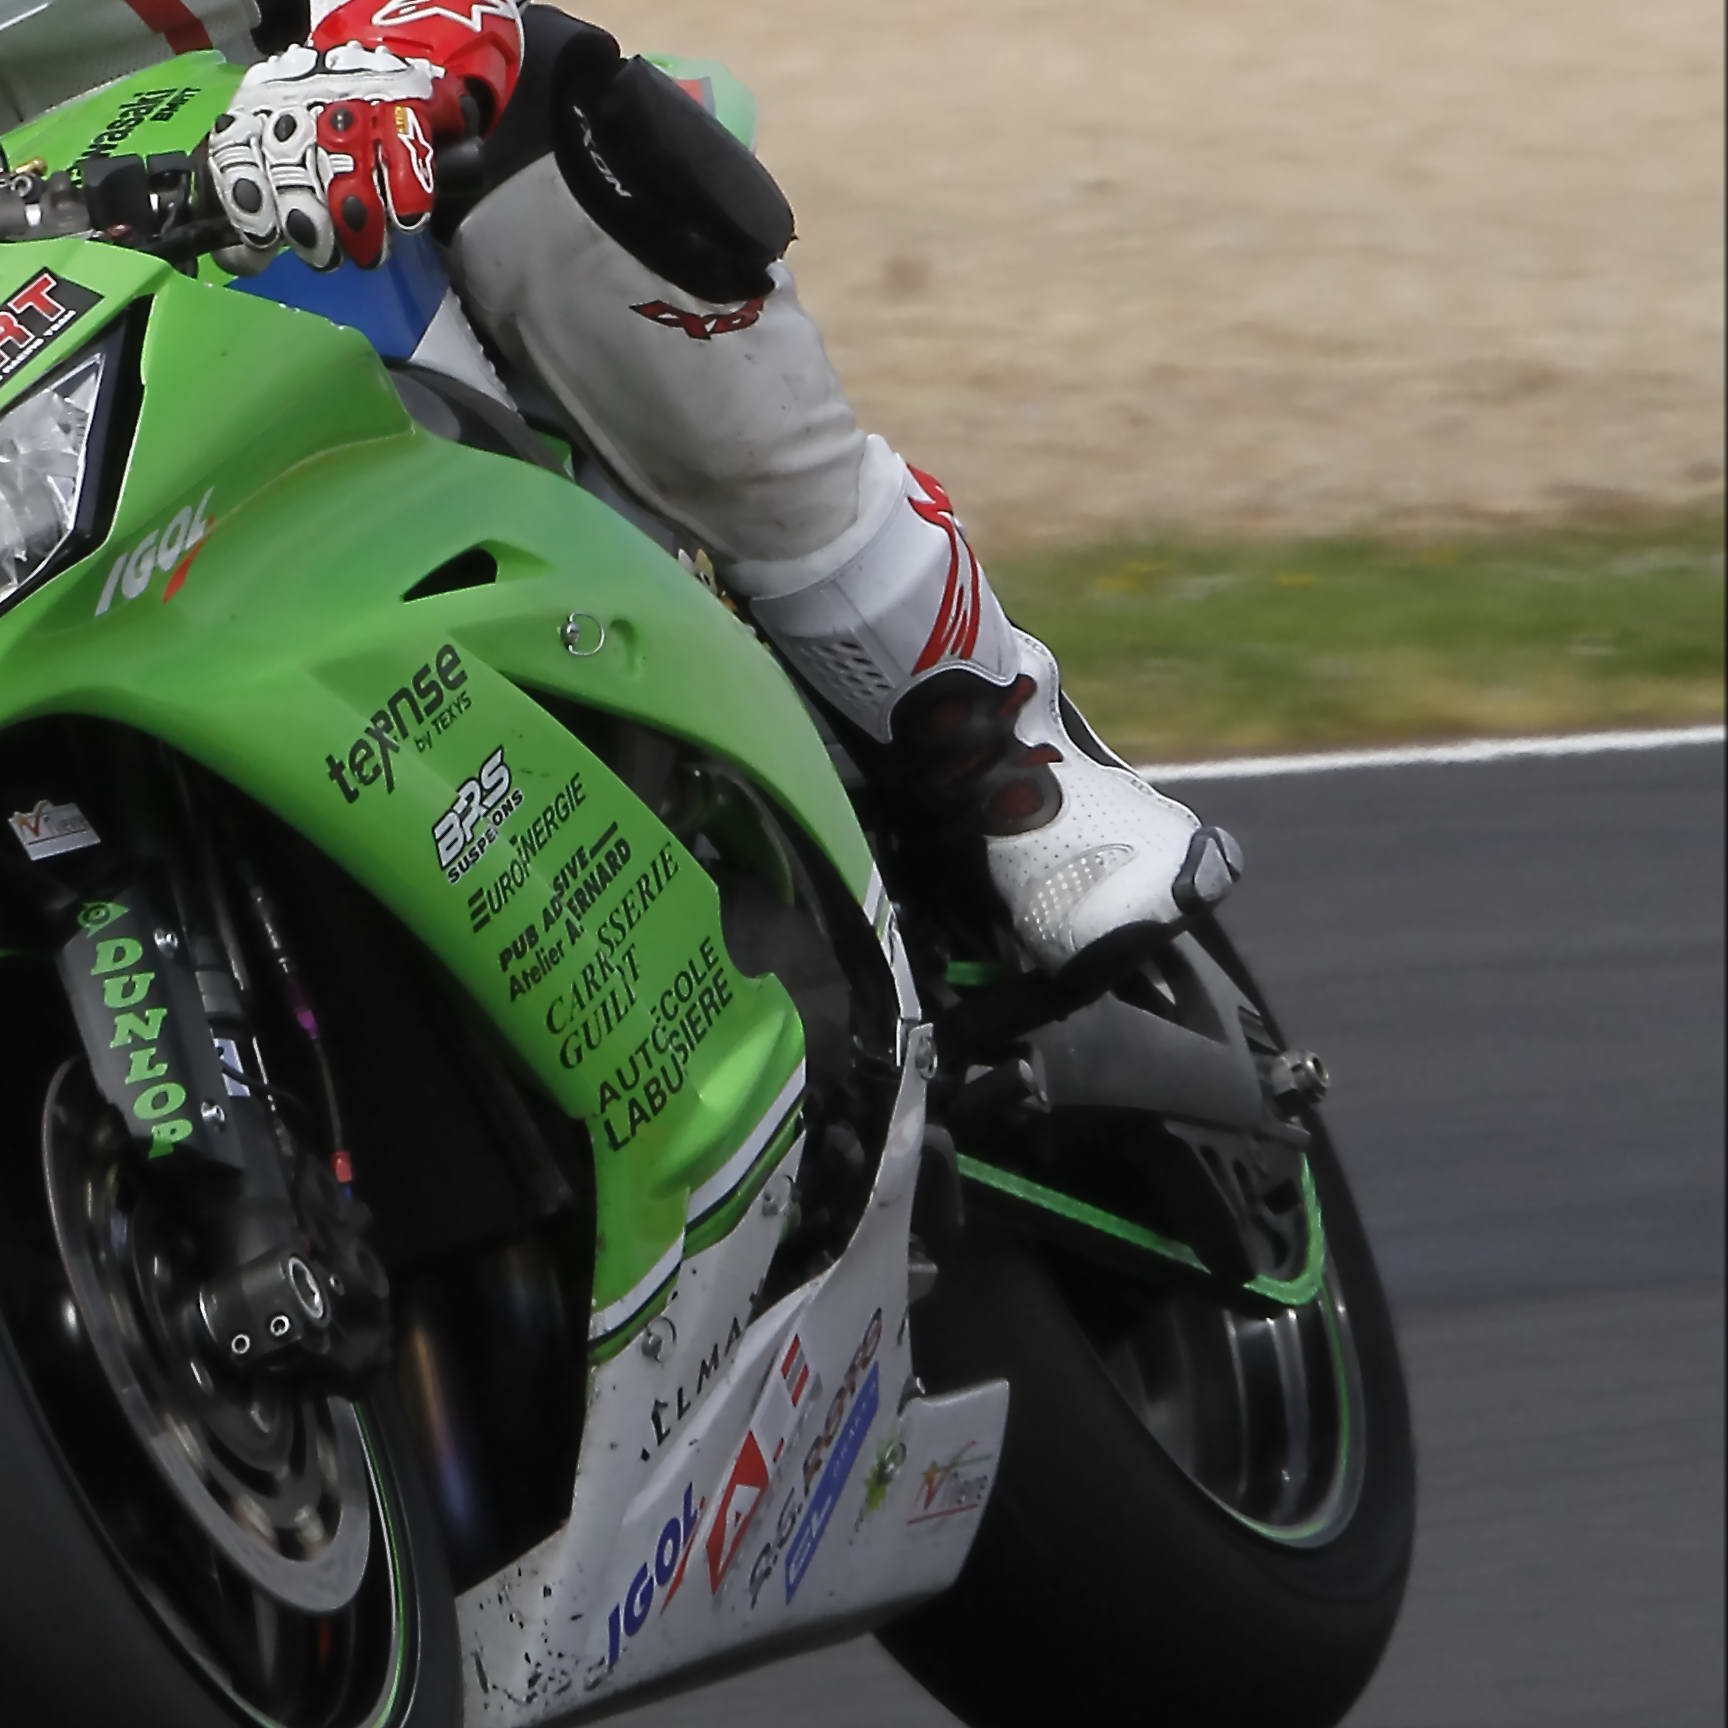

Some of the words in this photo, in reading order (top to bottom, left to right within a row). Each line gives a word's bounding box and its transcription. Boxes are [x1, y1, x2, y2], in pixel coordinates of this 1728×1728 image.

[68, 88, 178, 186] wasaki
[95, 486, 215, 617] IGOL
[414, 731, 432, 752] by
[431, 691, 472, 735] TEXYS
[432, 744, 512, 871] BRS
[499, 924, 539, 972] PUB
[509, 940, 565, 1002] Atelier
[566, 838, 631, 921] ERNARD
[546, 842, 680, 1034] CARRSSERIE
[90, 937, 194, 1159] DUNLOP
[607, 1481, 700, 1666] IGOL
